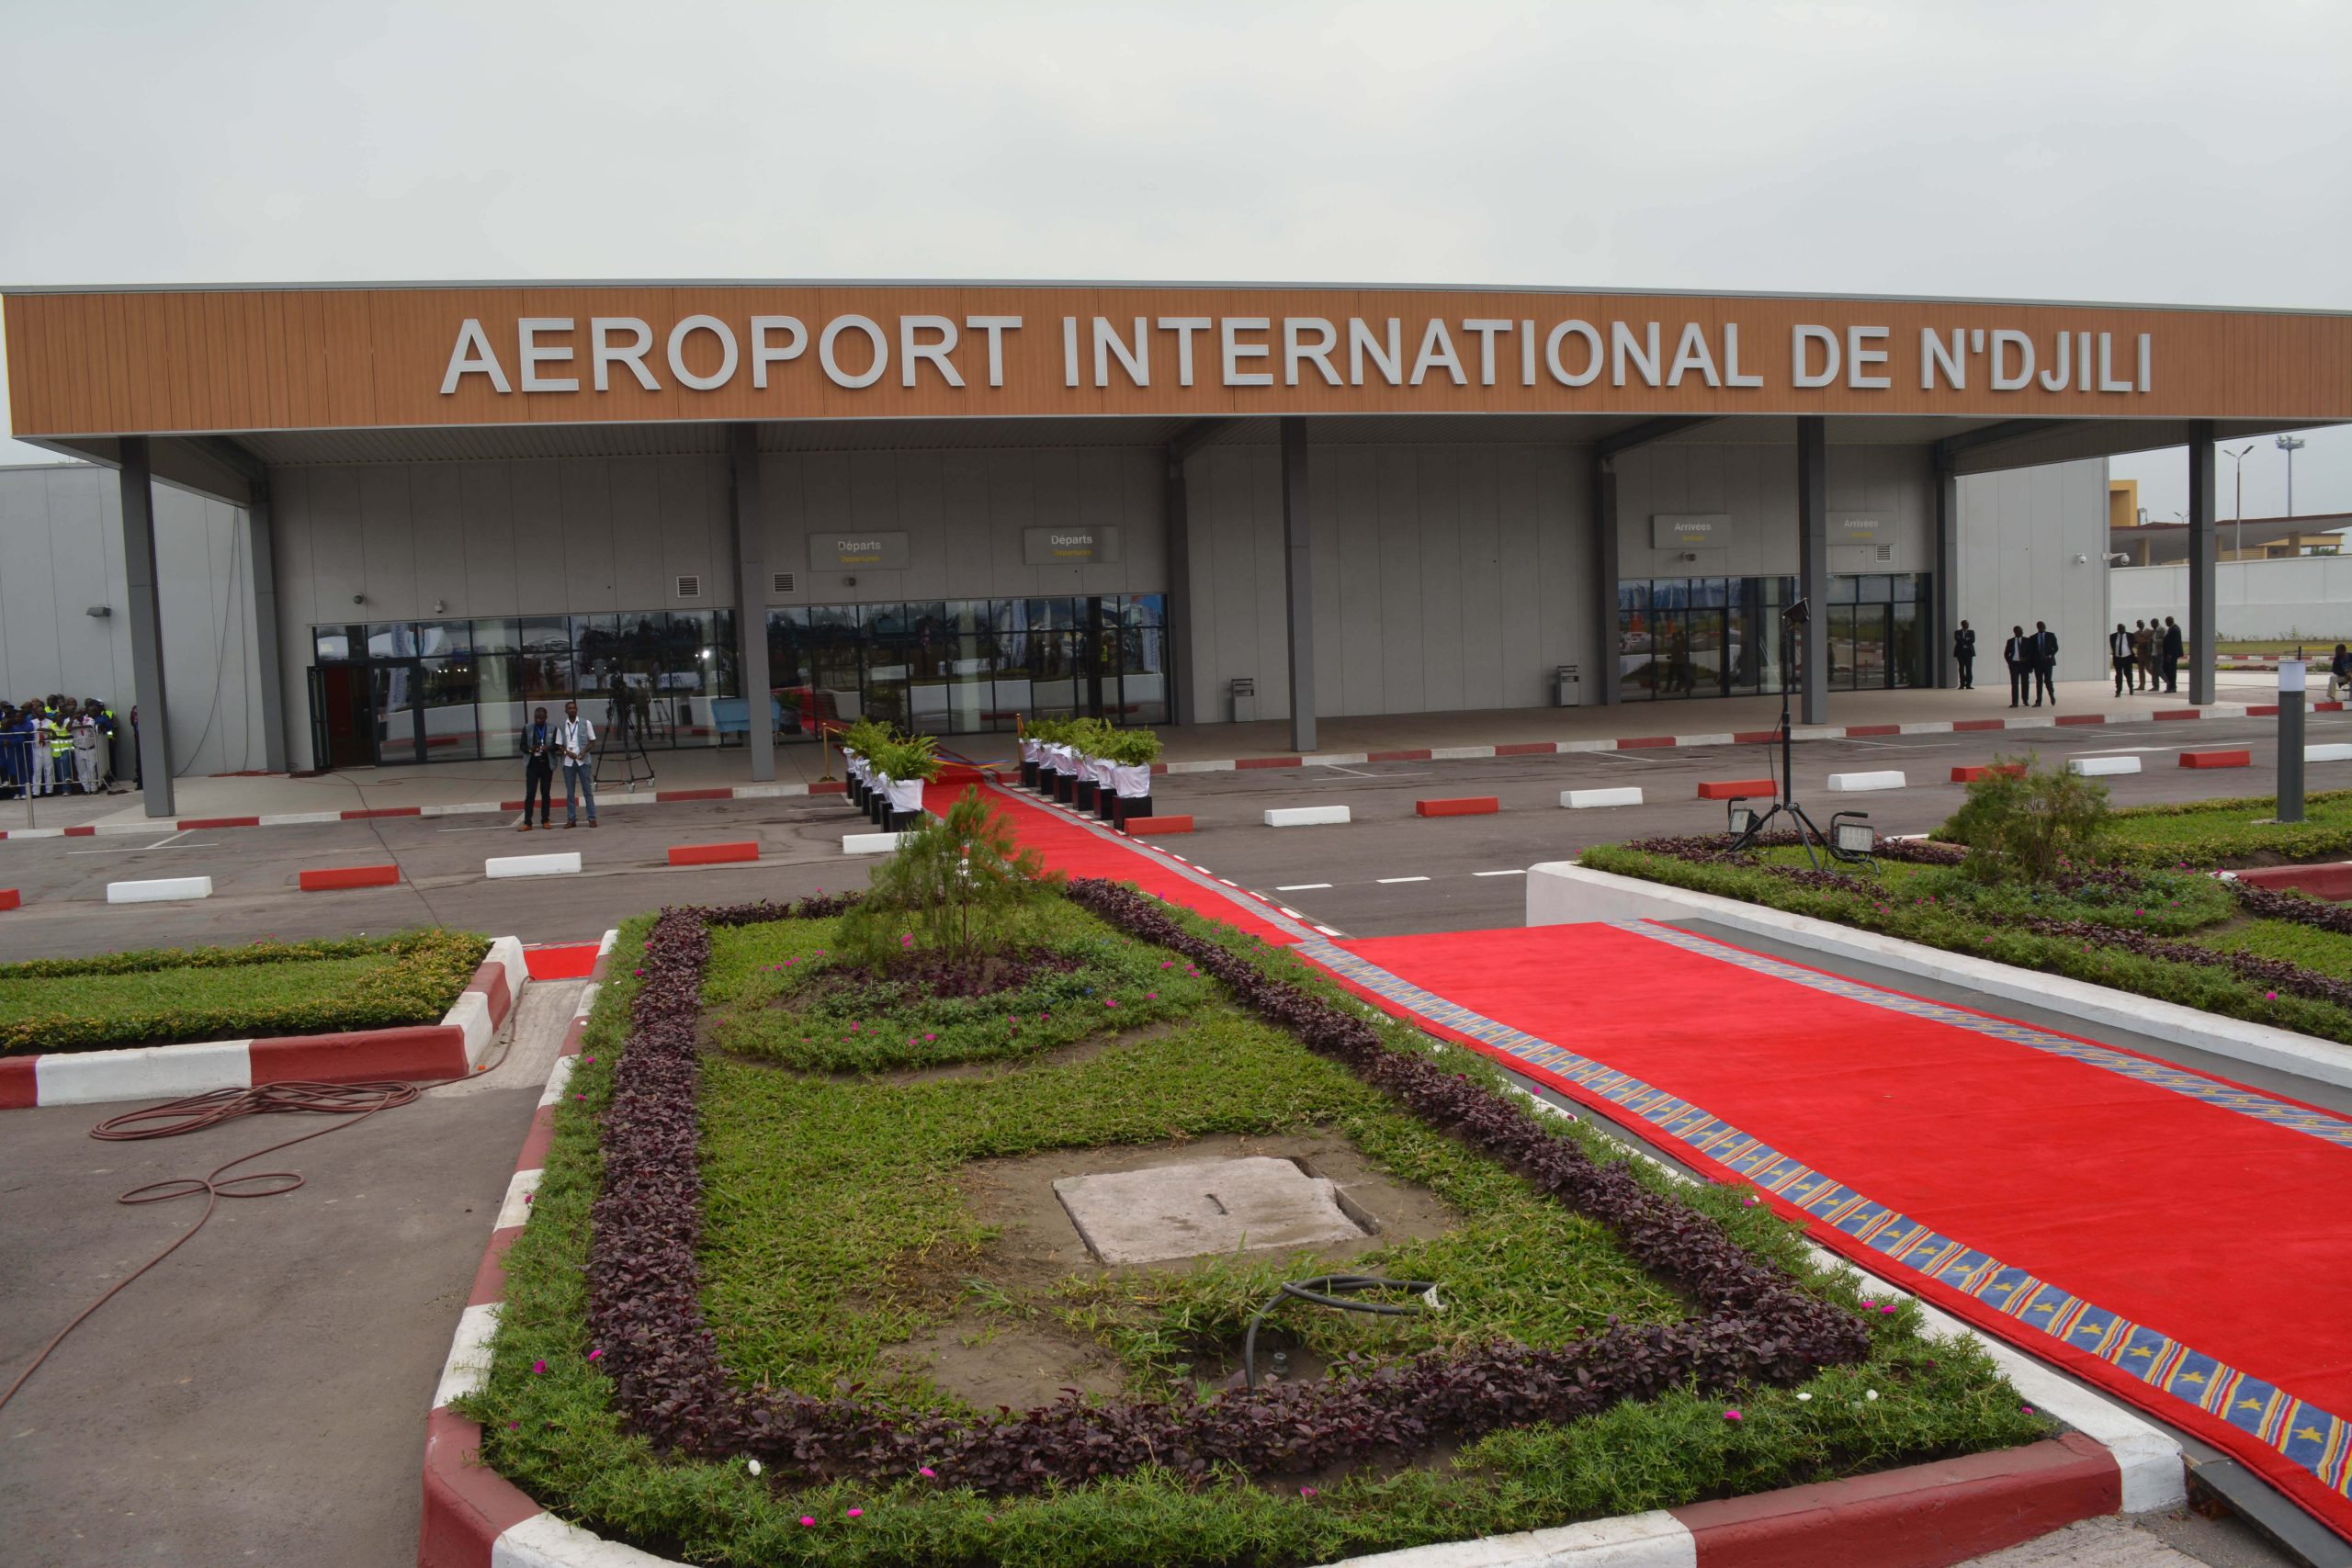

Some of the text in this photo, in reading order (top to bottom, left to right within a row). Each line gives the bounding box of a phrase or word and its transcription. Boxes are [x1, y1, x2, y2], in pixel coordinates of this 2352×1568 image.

[440, 315, 2151, 394] AEROPORT INTERNATIONAL DE N'DJILI
[1674, 521, 1712, 531] Arrivées
[837, 539, 882, 553] Départs
[1051, 534, 1093, 547] Départs
